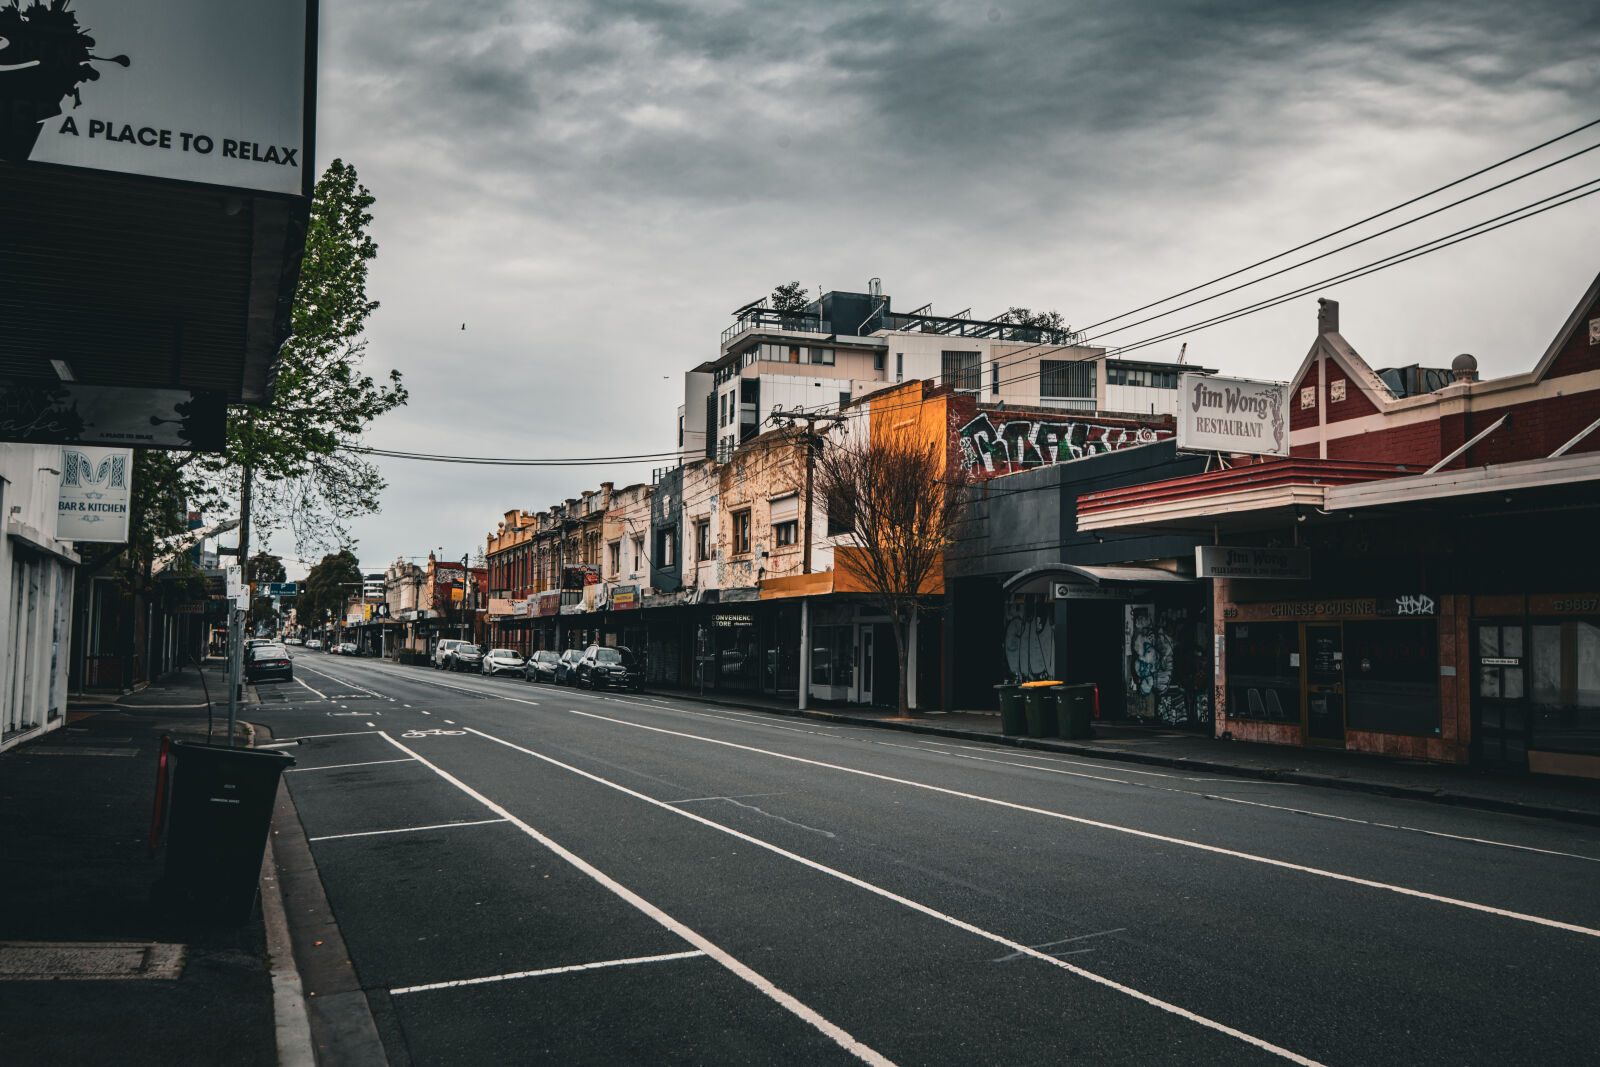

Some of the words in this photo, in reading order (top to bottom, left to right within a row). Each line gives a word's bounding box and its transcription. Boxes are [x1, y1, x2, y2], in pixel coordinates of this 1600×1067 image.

[59, 116, 79, 136] A
[88, 119, 172, 149] PLACE
[179, 132, 214, 154] TO
[222, 138, 298, 167] RELAX
[1192, 382, 1223, 413] Jim
[1225, 387, 1268, 420] Wong
[1196, 416, 1264, 438] RESTAURANT
[58, 501, 77, 511] BAR
[78, 502, 86, 511] &
[88, 503, 126, 513] KITCHEN
[1271, 601, 1315, 616] CHINESE
[1326, 600, 1372, 615] CUISINE
